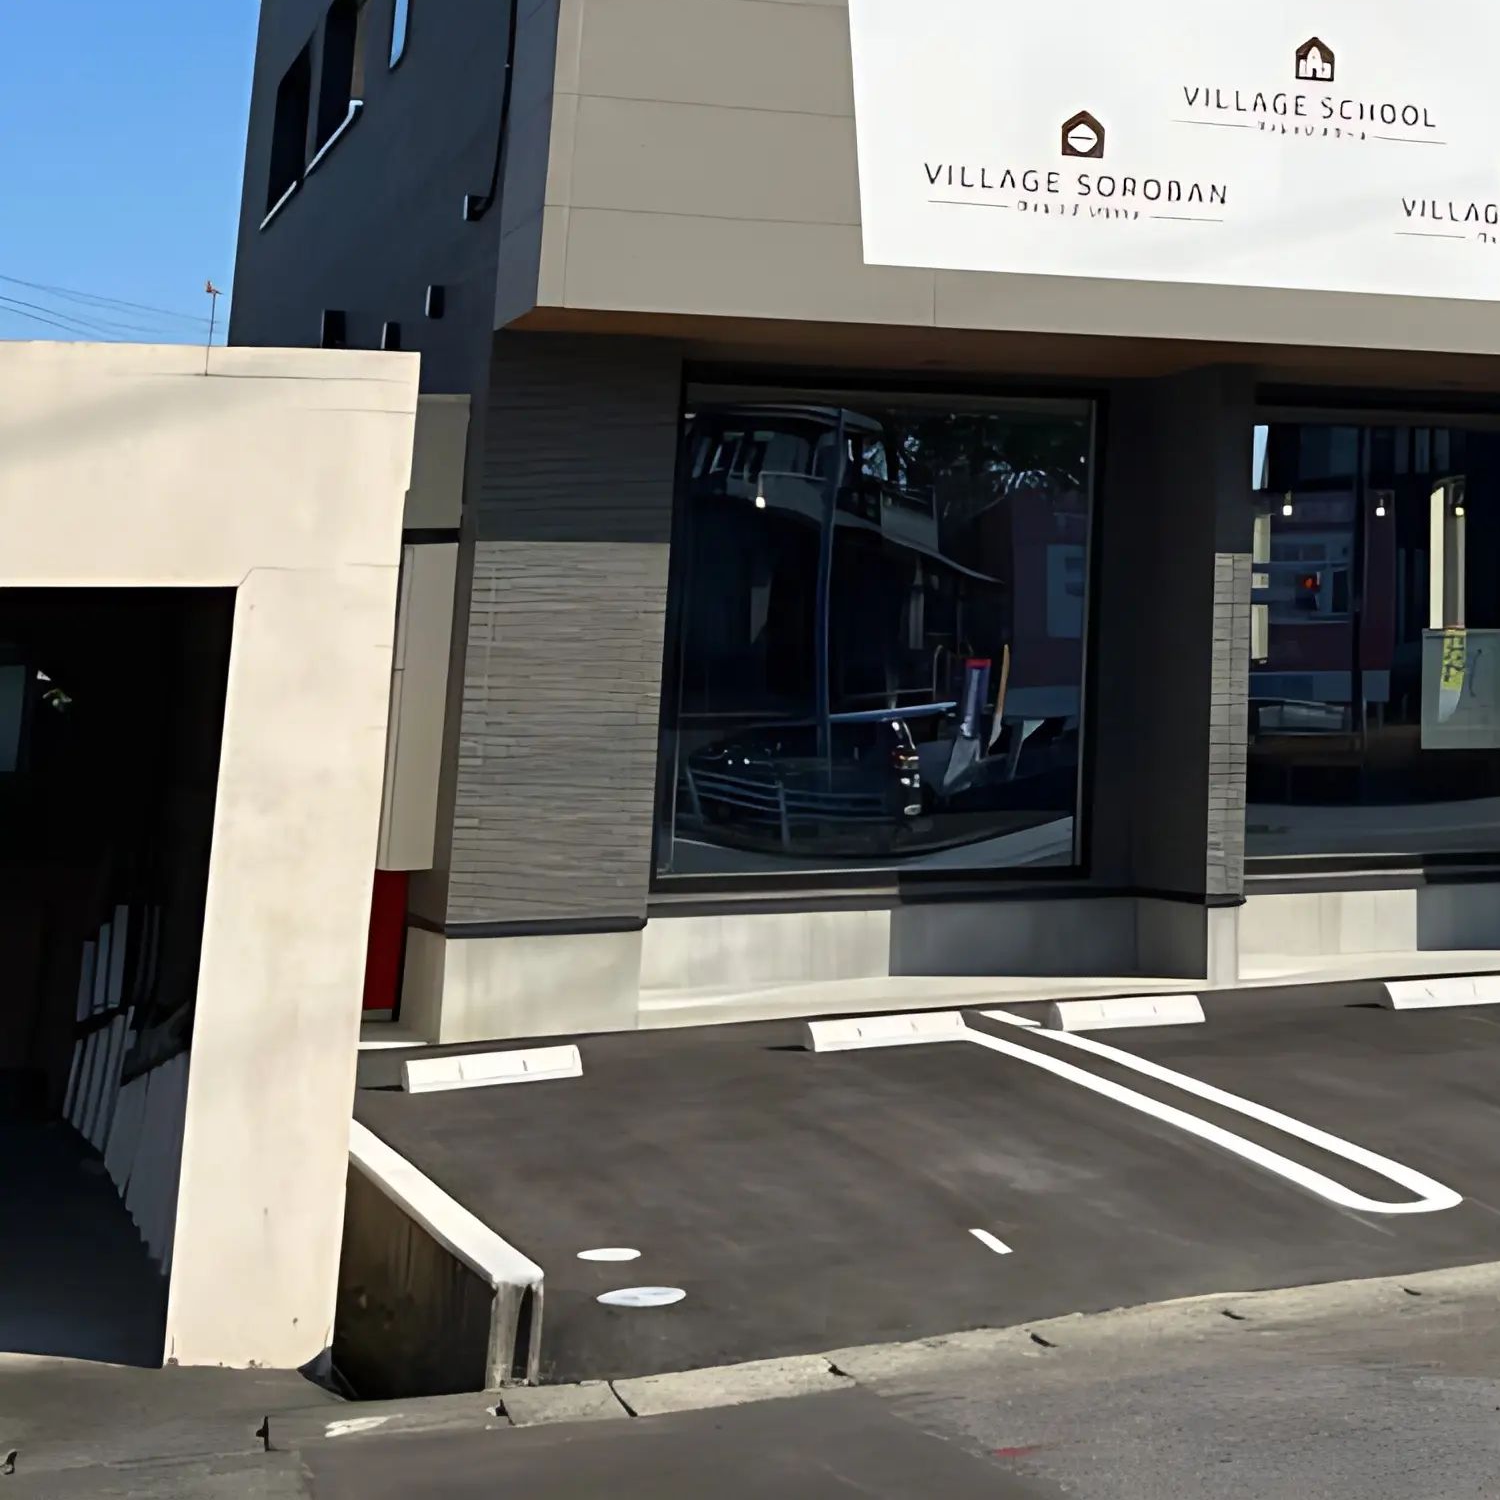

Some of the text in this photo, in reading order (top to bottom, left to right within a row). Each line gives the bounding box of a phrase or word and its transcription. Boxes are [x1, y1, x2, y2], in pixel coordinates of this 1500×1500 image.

[1183, 86, 1436, 128] VILLAGE SCHOOL
[924, 162, 1060, 194] VILLAGE
